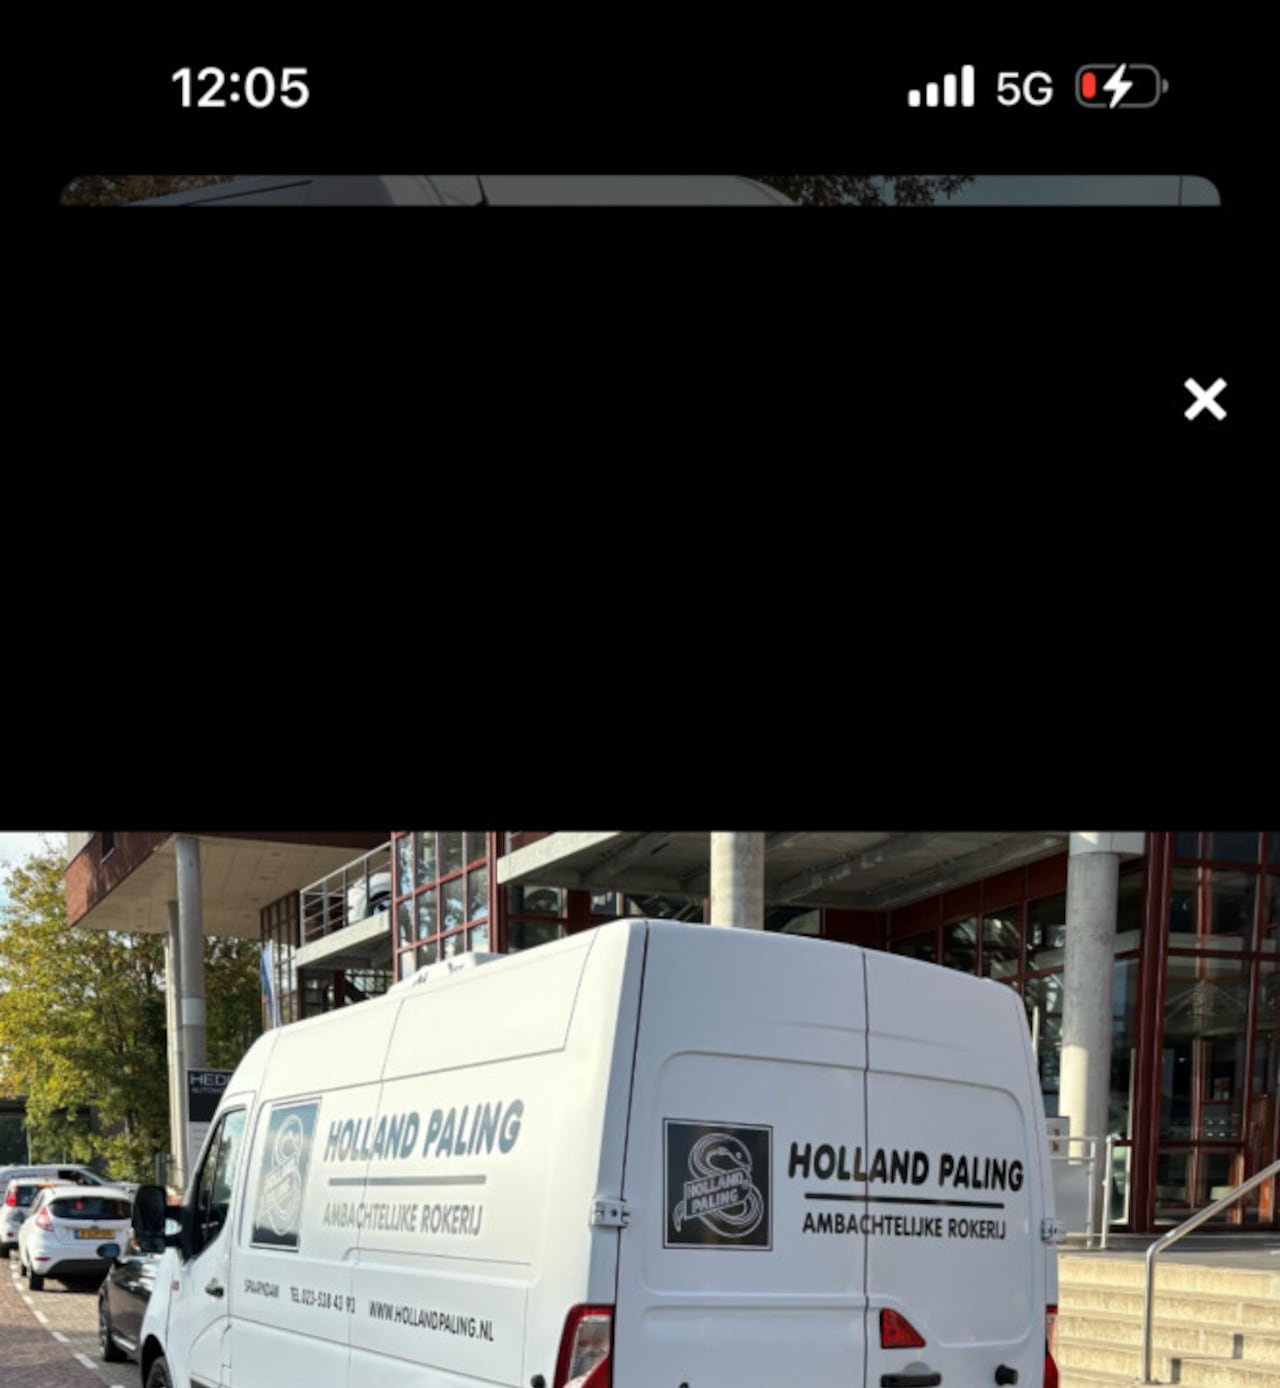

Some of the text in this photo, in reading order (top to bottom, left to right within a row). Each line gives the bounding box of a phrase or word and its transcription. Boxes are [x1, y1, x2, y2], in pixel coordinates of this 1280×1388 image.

[323, 1098, 524, 1162] HOLLAND PALING
[787, 1141, 1024, 1192] HOLLAND PALING
[687, 1171, 744, 1214] HOLLAND PALING
[322, 1203, 483, 1236] AMBACHTELIJKE ROKERIJ
[802, 1212, 1006, 1240] AMBACHTELIJKE ROKERIJ
[369, 1300, 494, 1342] WWW.HOLLANDPALING.NL
